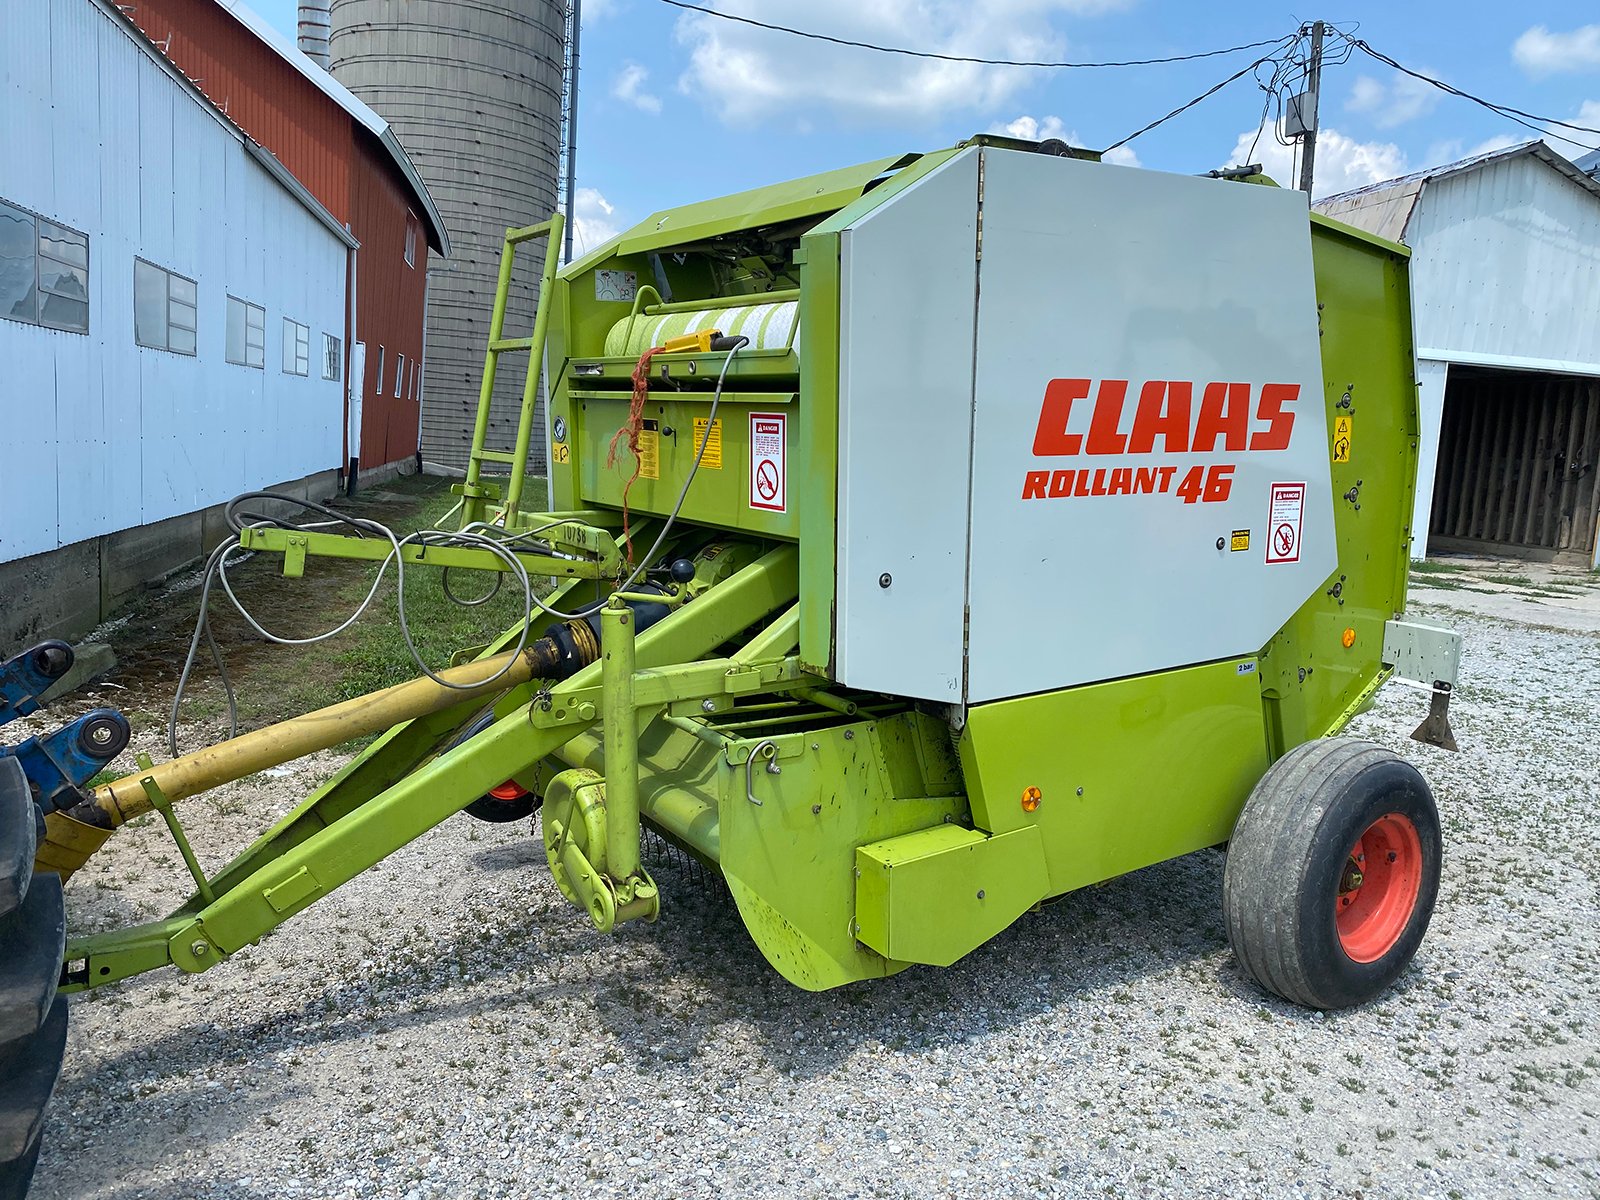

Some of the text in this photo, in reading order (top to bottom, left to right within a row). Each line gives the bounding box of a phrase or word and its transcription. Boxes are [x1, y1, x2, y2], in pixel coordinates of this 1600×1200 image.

[1032, 378, 1301, 456] CLAAS
[1021, 464, 1236, 504] ROLLANT 46
[1243, 663, 1253, 671] bar
